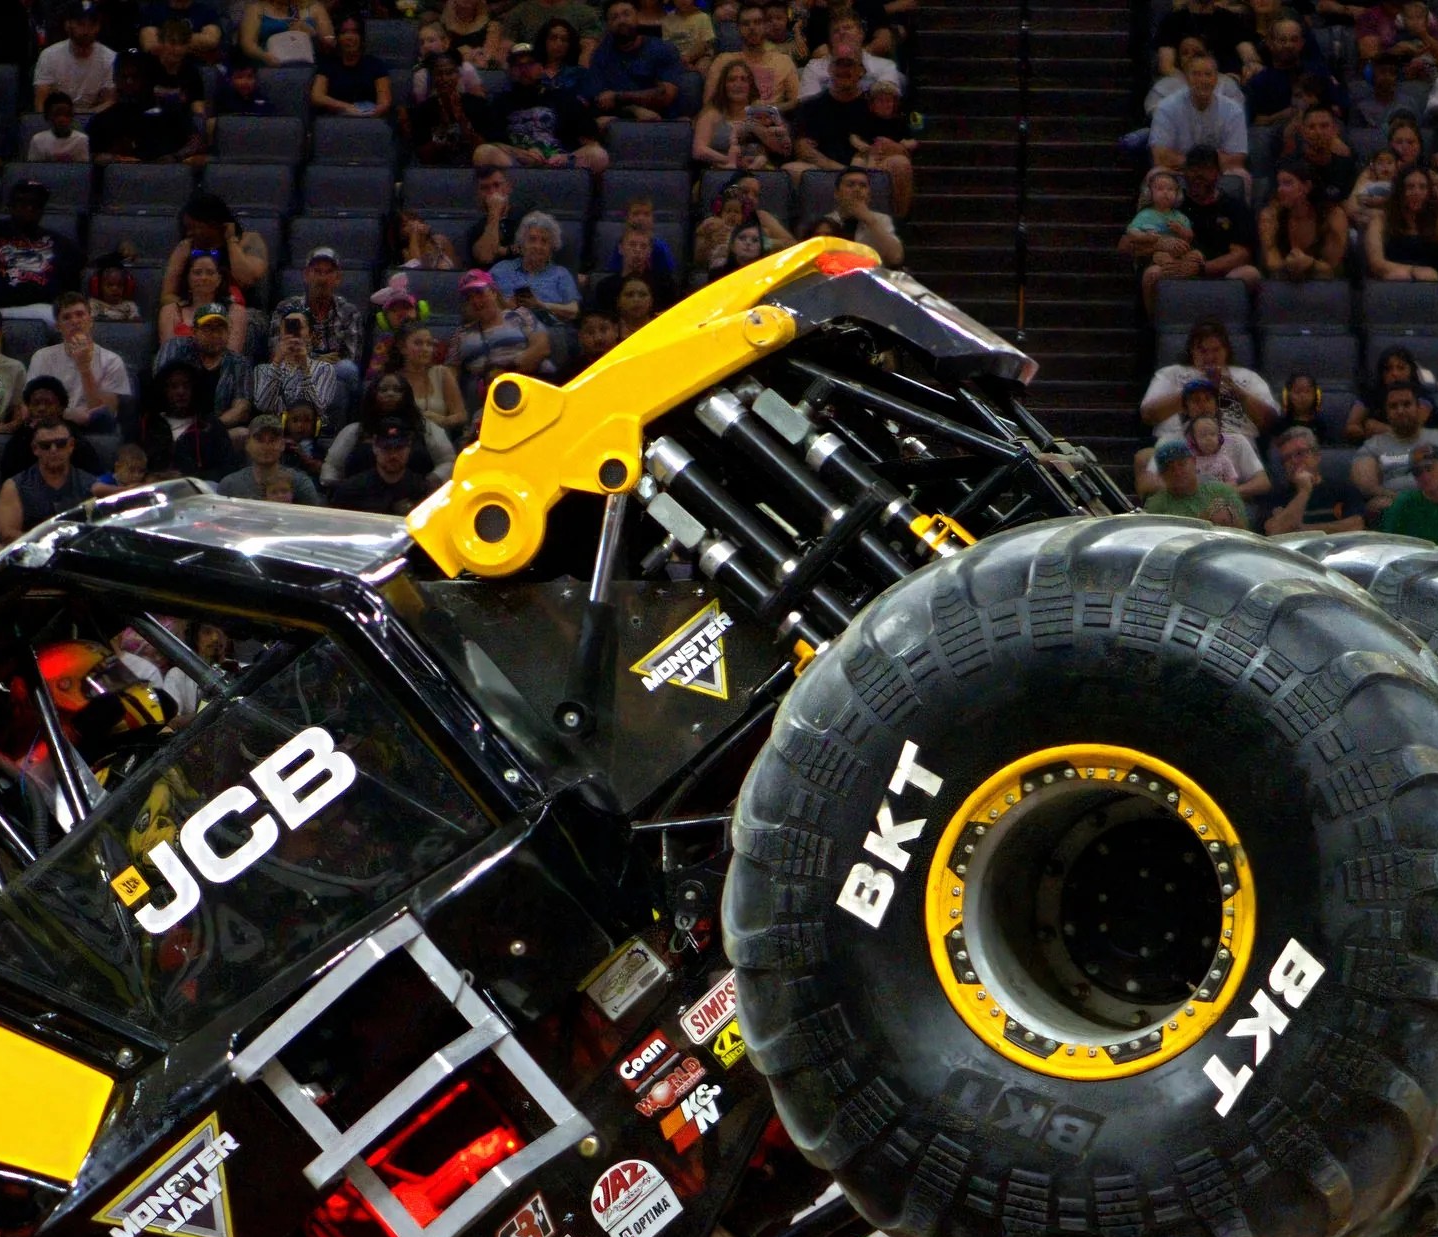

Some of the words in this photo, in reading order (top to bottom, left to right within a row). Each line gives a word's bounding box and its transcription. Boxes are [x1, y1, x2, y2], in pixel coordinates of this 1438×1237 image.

[642, 611, 734, 692] MONSTER
[681, 642, 723, 685] JAM
[134, 726, 357, 934] JCB
[836, 740, 944, 927] BKT
[1202, 936, 1326, 1117] BKT
[620, 1039, 666, 1080] Coan
[166, 1175, 223, 1232] JAM
[593, 1162, 648, 1213] JAZ
[633, 1197, 671, 1235] OPTIMA
